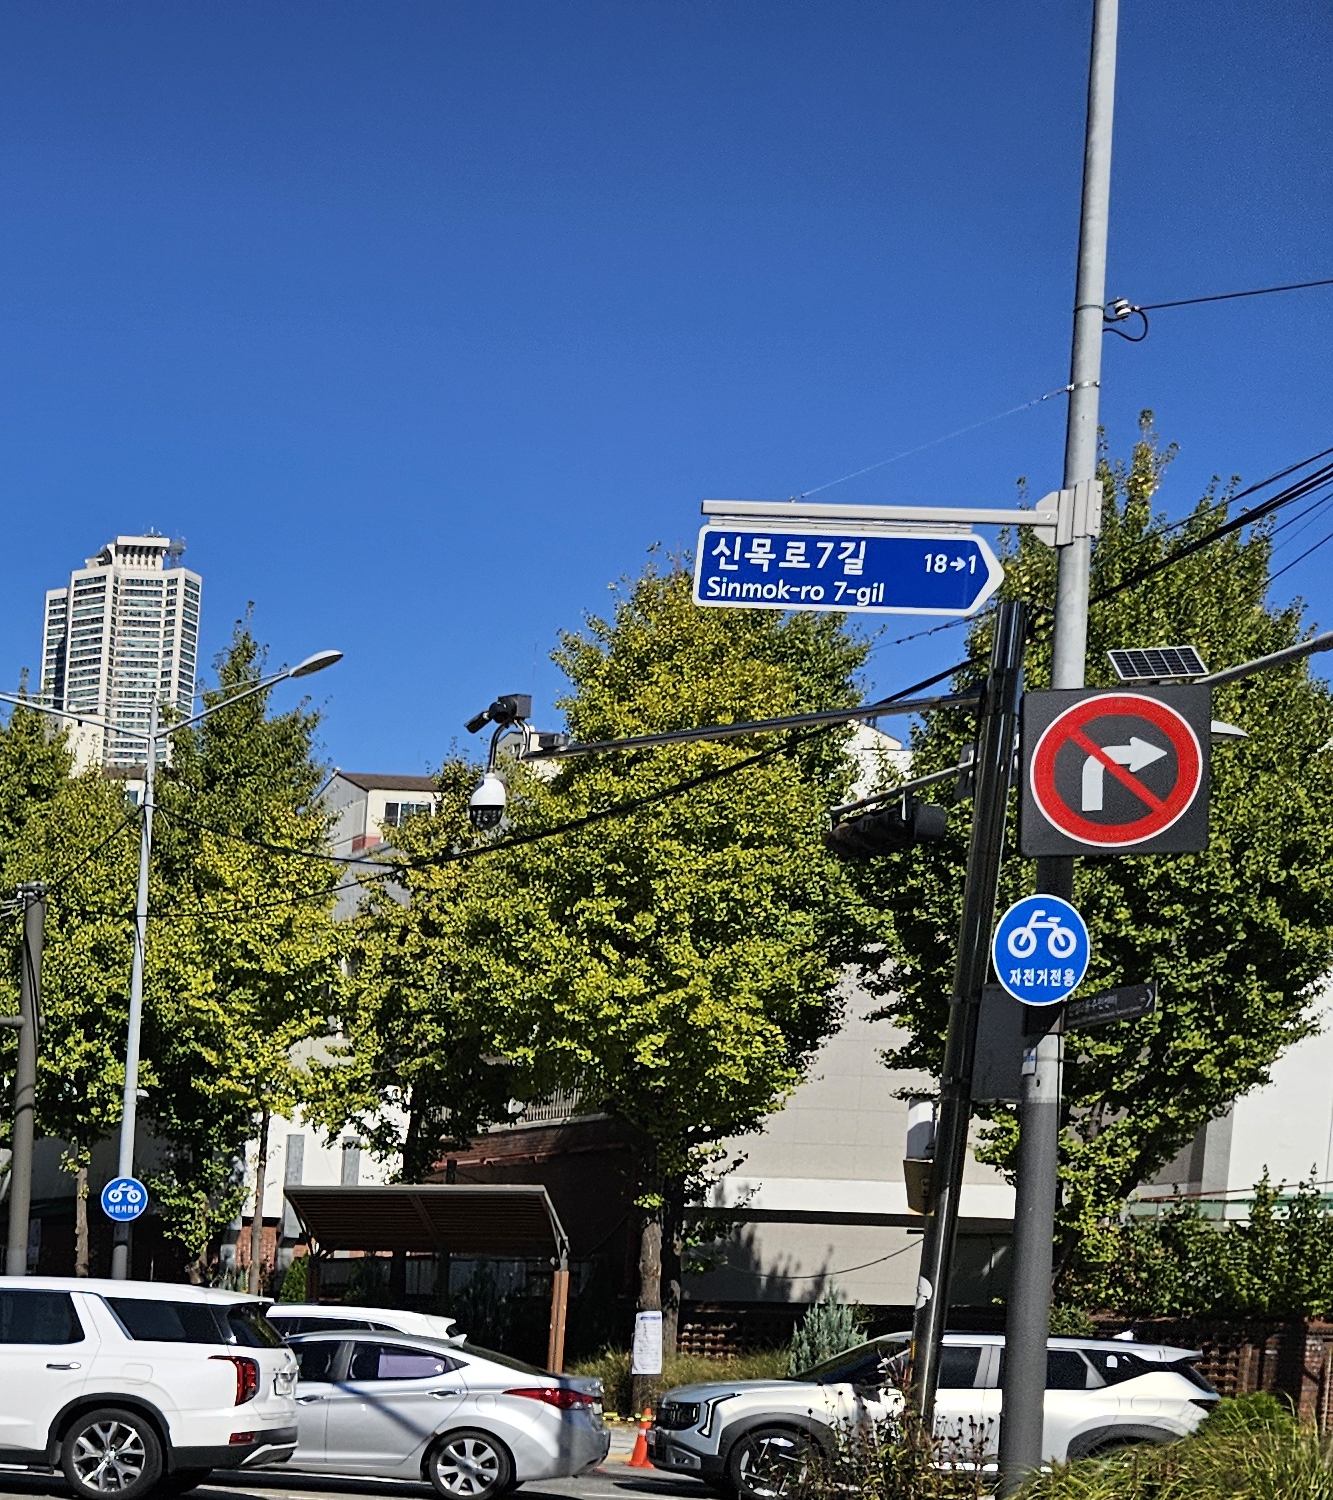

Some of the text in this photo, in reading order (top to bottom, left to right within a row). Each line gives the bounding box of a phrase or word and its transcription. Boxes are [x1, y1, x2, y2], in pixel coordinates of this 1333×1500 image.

[711, 536, 867, 576] 신목로7길
[705, 576, 885, 607] Sinmok-ro 7-gil
[1008, 967, 1076, 988] 자전거전용
